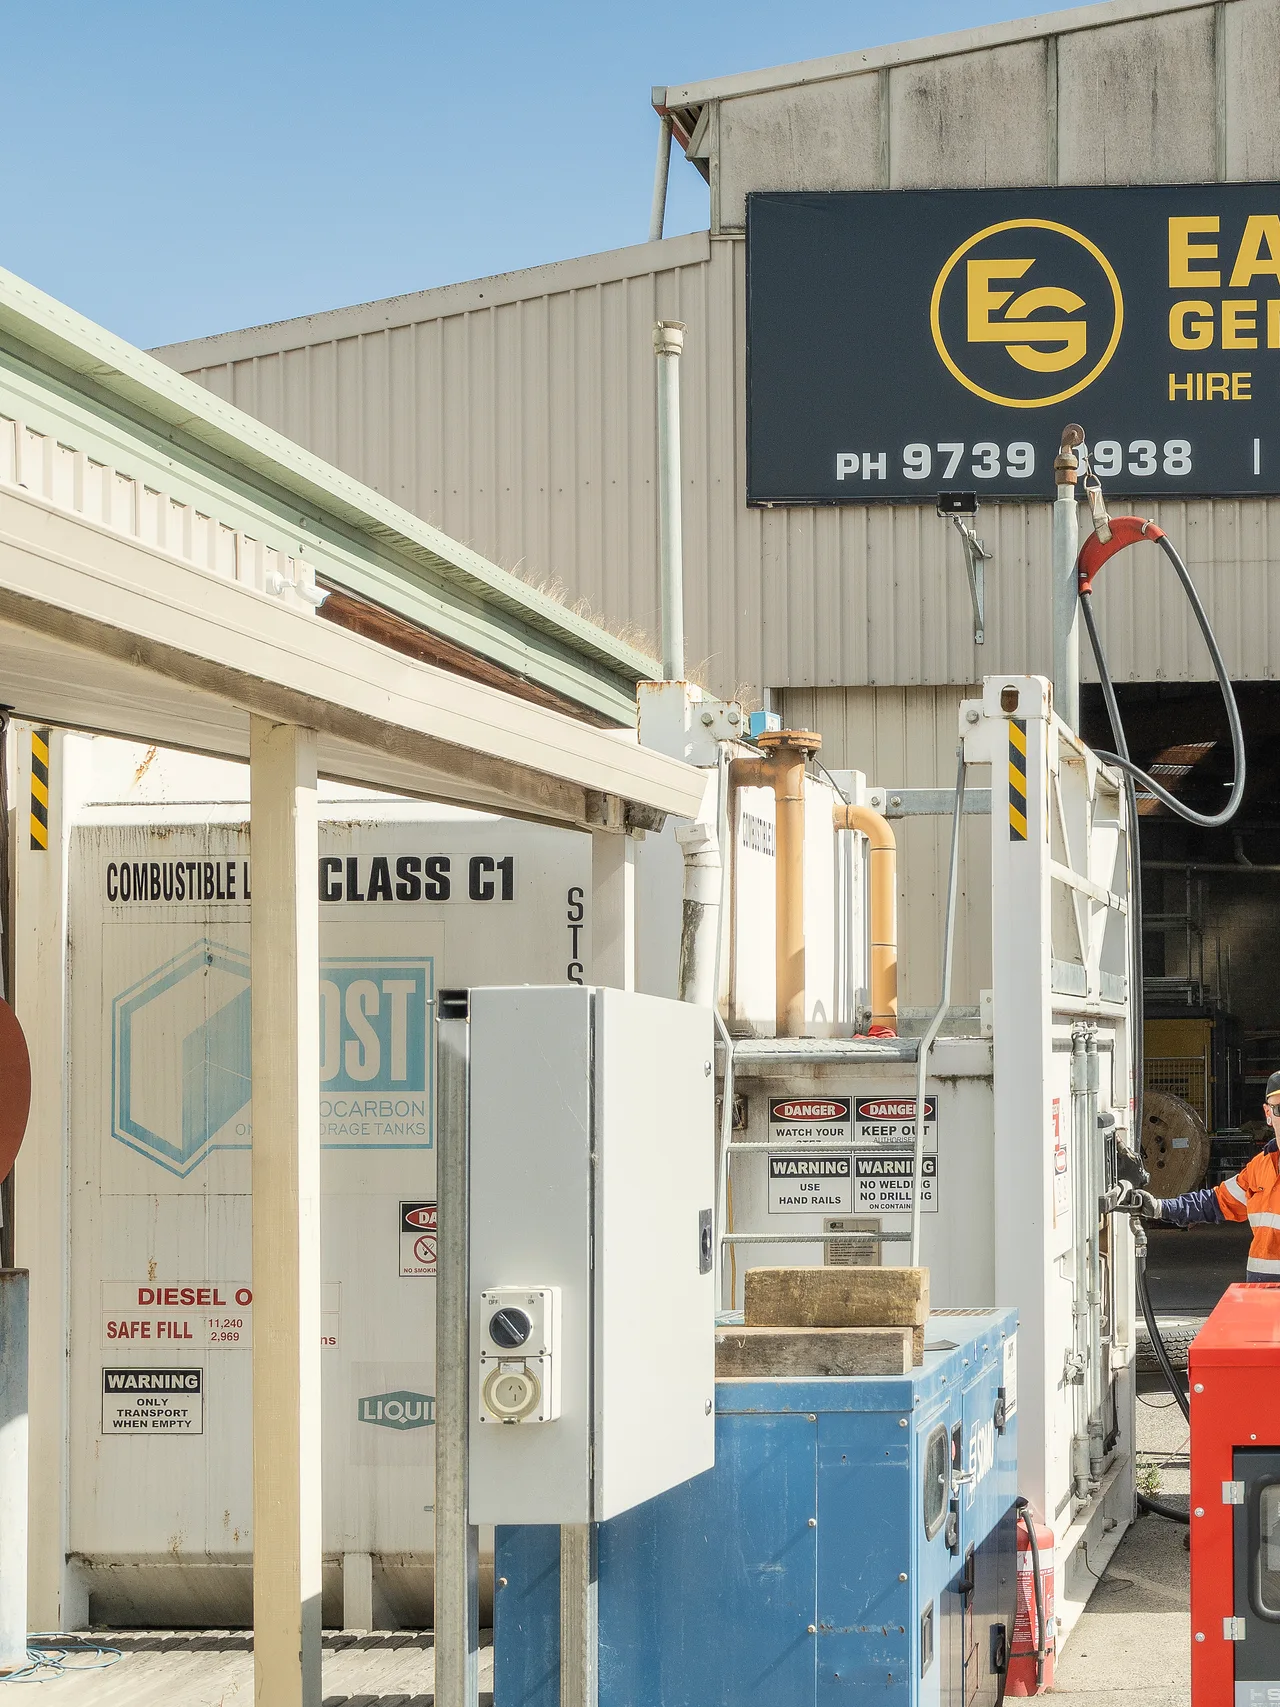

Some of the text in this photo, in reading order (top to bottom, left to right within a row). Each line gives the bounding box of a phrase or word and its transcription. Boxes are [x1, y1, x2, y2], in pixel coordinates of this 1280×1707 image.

[1168, 372, 1252, 401] HIRE
[836, 452, 887, 480] PH
[902, 441, 1035, 479] 9739
[107, 862, 236, 901] COMBUSTIBLE
[318, 856, 451, 902] CLASS
[469, 856, 514, 901] C1
[319, 1100, 425, 1118] OCARBON
[784, 1105, 836, 1116] DANGER
[374, 1122, 426, 1136] TANKS
[776, 1128, 845, 1137] WATCH YOUR
[861, 1125, 897, 1136] KEEP
[772, 1160, 849, 1175] WARNING
[858, 1160, 934, 1174] WARNIG
[799, 1183, 821, 1192] USE
[860, 1180, 931, 1189] NO WELDIG
[779, 1196, 842, 1205] HAND RAILS
[860, 1191, 932, 1201] NO DRILLG
[138, 1288, 226, 1306] DIESEL
[106, 1320, 193, 1339] SAFE FILL
[208, 1319, 243, 1329] 11,240
[210, 1332, 240, 1342] 2,969
[107, 1374, 198, 1389] WARNING
[136, 1398, 168, 1406] ONLY
[117, 1409, 188, 1417] TRANSPORT
[112, 1420, 192, 1428] WHEN EMPTY
